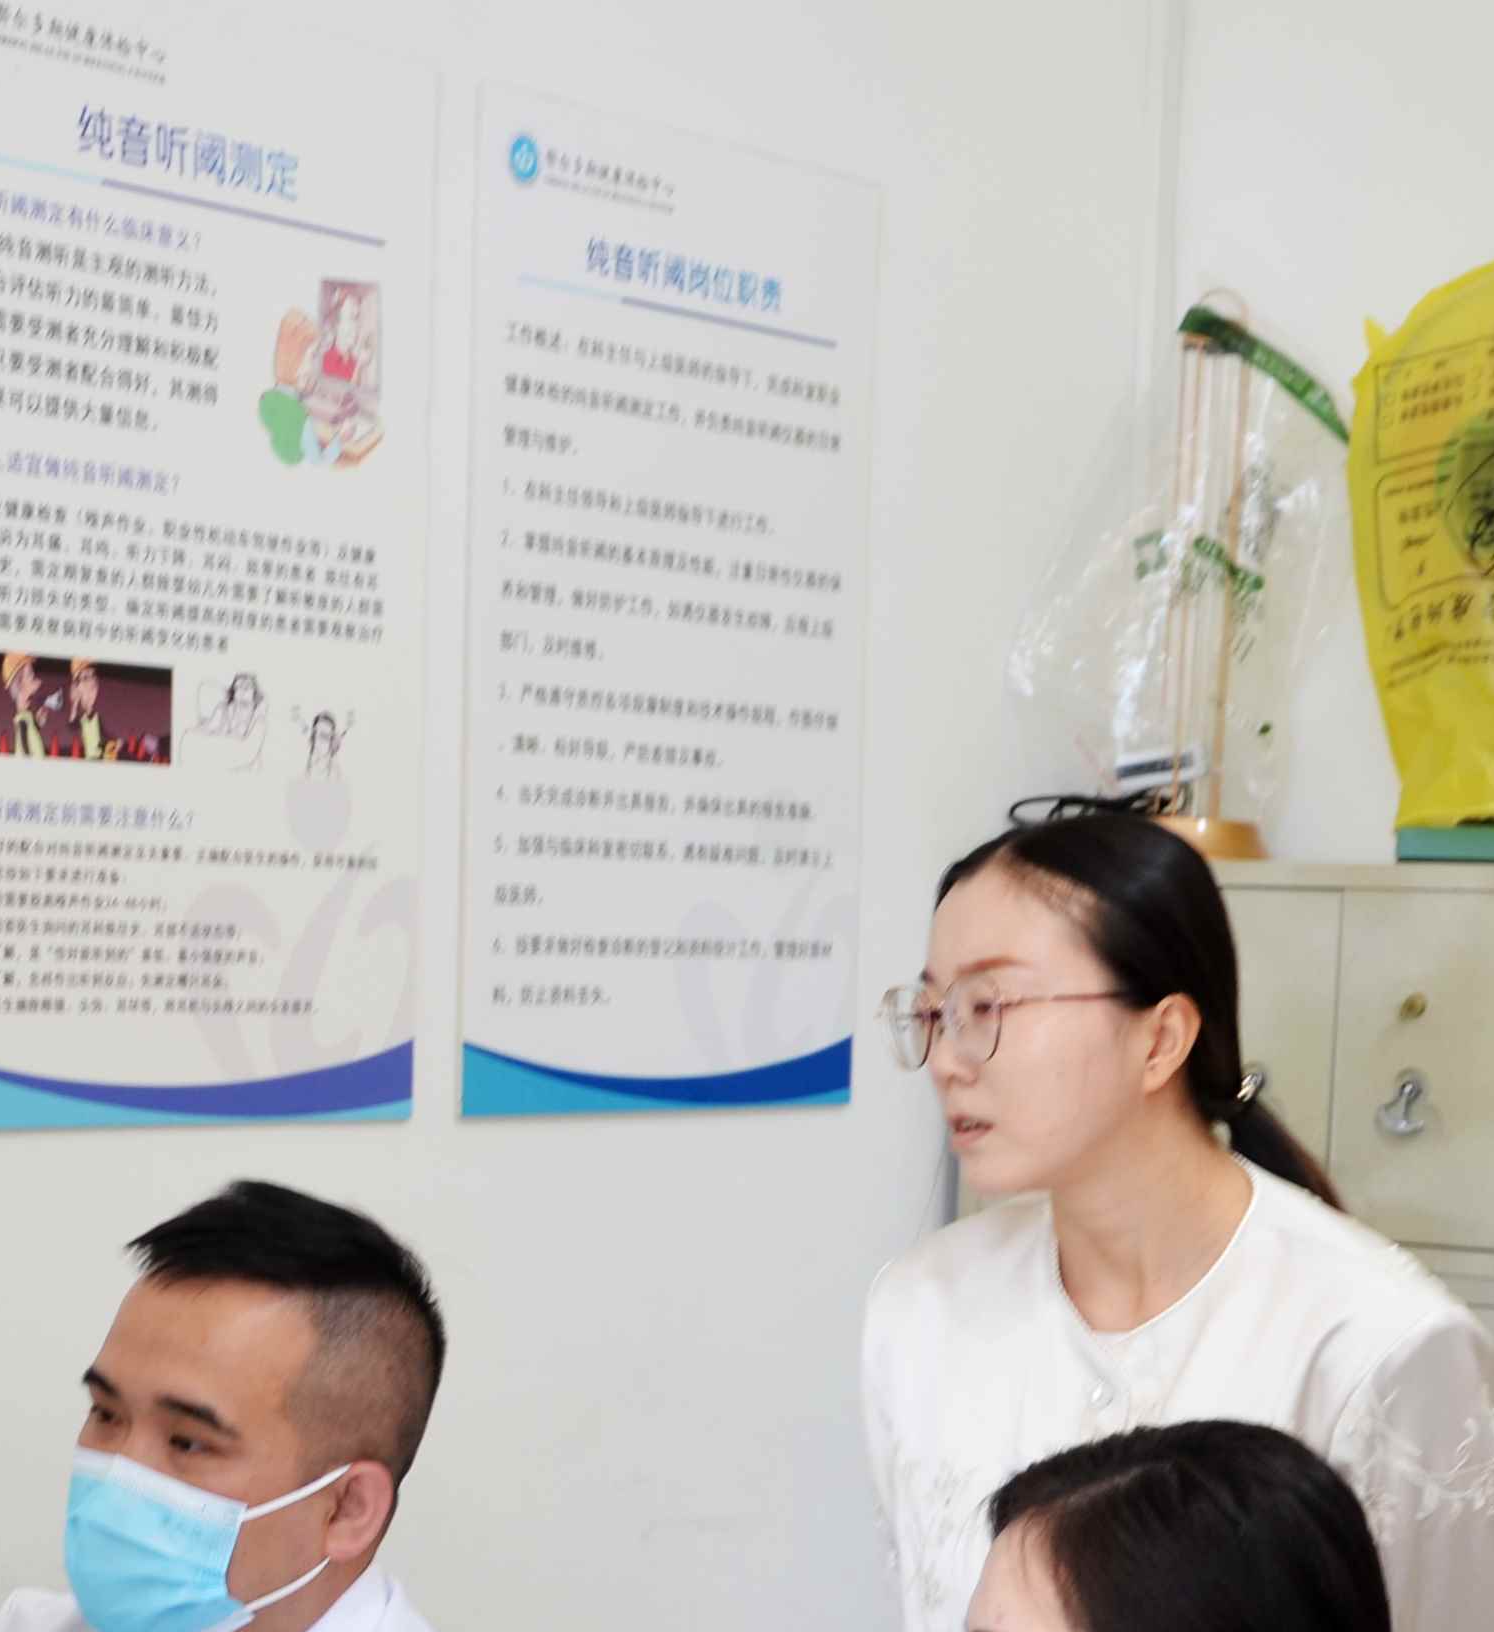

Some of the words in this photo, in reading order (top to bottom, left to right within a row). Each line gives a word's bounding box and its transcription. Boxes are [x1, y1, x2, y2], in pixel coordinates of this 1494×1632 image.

[78, 104, 299, 202] 纯音听阈测定
[585, 236, 782, 312] 纯音听阈岗位职责
